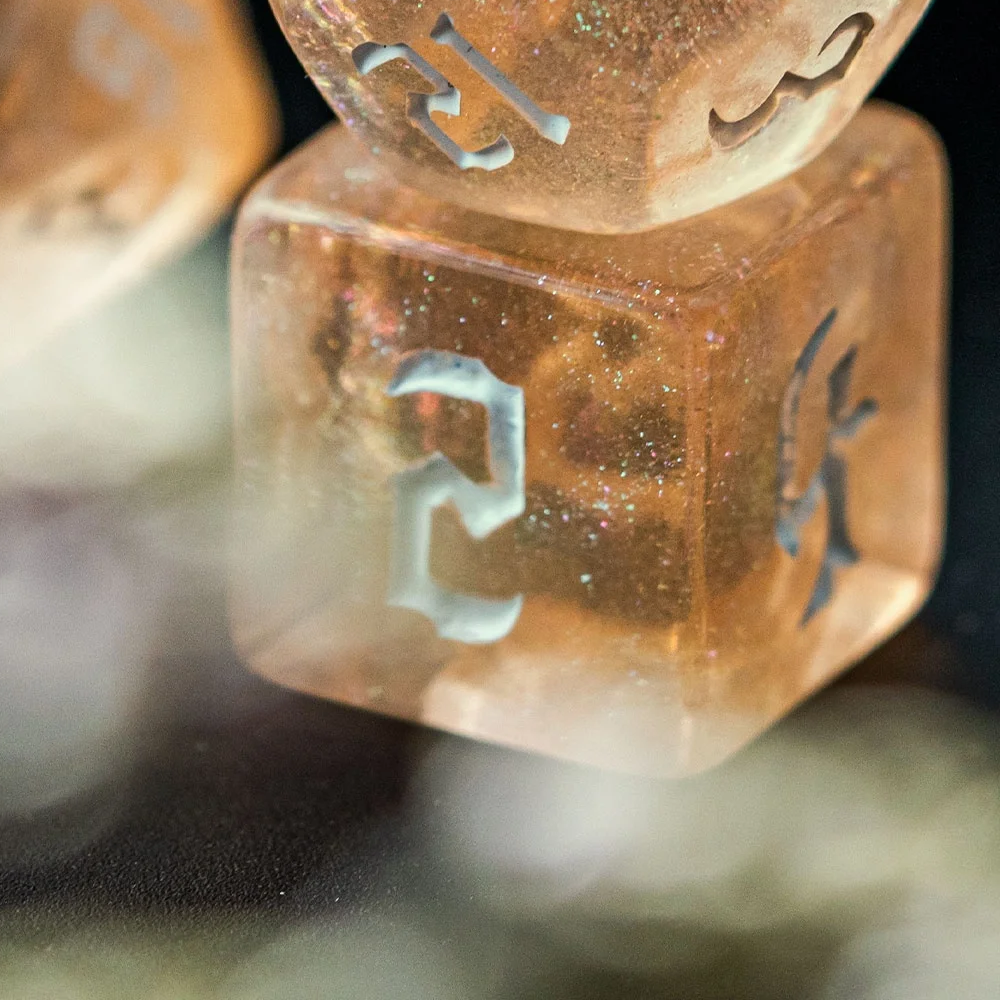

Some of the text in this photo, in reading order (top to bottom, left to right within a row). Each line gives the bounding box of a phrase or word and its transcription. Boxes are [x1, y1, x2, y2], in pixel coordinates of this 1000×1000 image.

[351, 11, 572, 171] 12
[708, 11, 875, 150] 3
[386, 348, 527, 644] 2
